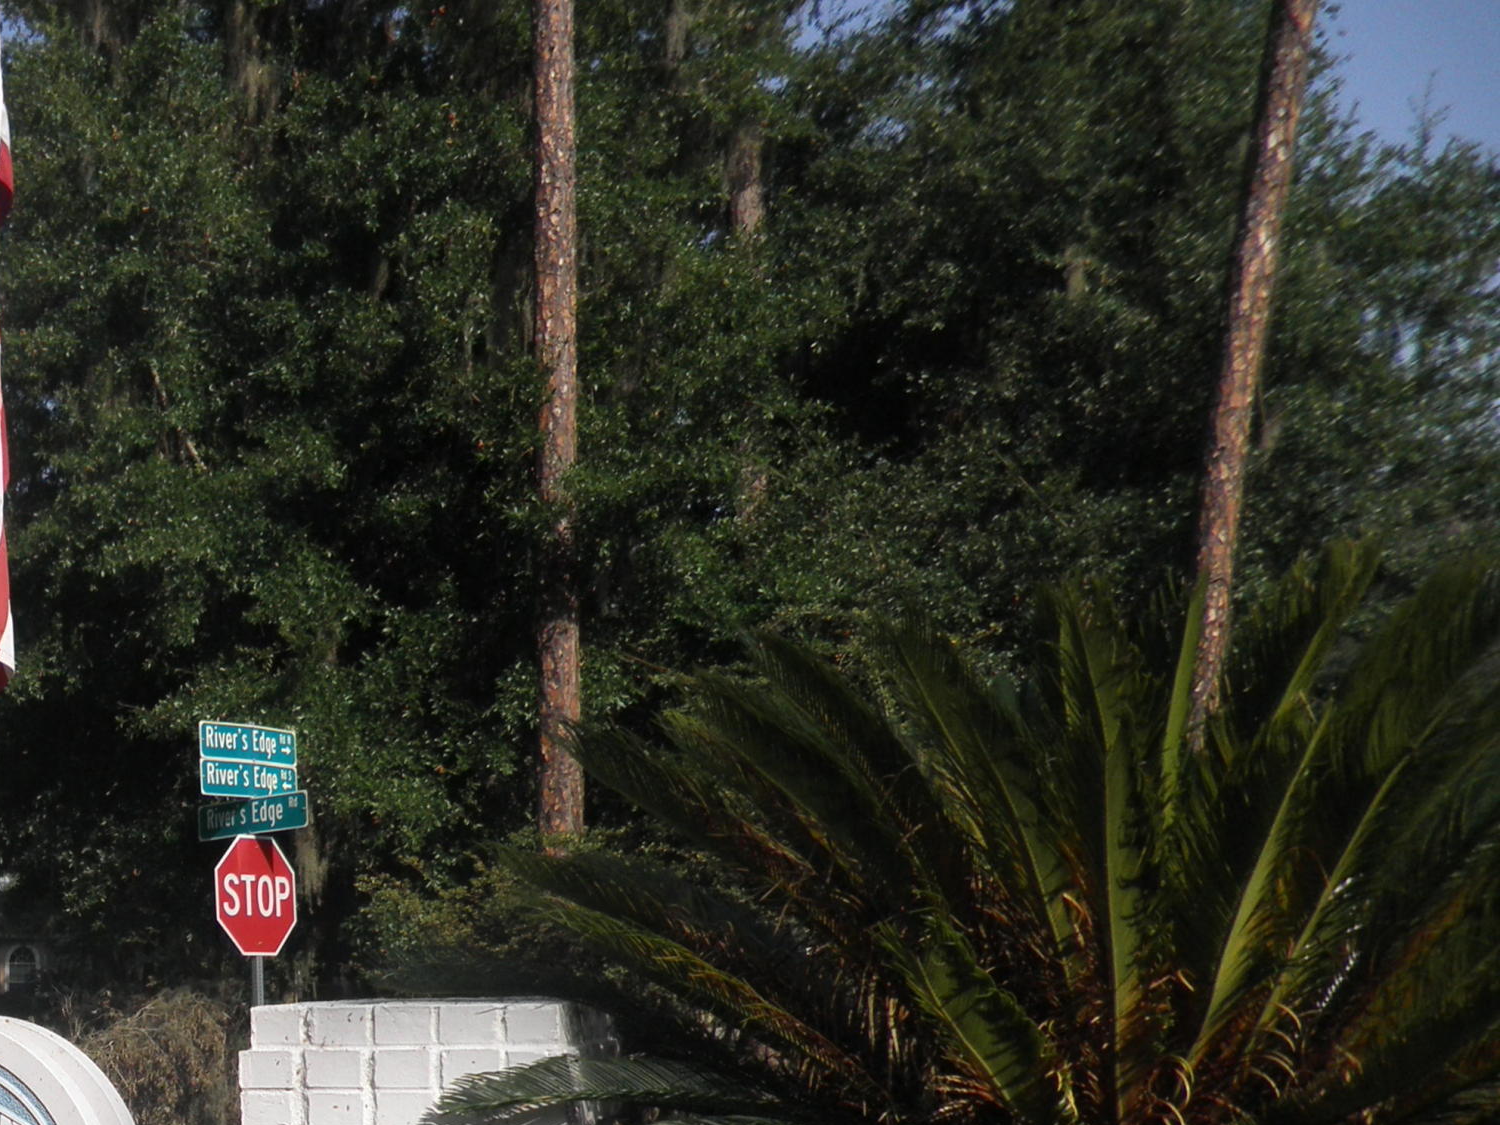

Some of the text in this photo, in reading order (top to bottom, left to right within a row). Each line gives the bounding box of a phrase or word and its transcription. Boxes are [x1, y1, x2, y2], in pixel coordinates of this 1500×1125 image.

[205, 725, 248, 751] River's
[252, 730, 277, 759] Edge
[279, 734, 286, 744] Rd
[206, 763, 250, 787] River's
[253, 767, 278, 795] Edge
[280, 769, 287, 780] Rd
[251, 800, 283, 827] Edge
[288, 796, 298, 808] Rd
[222, 873, 290, 918] STOP
